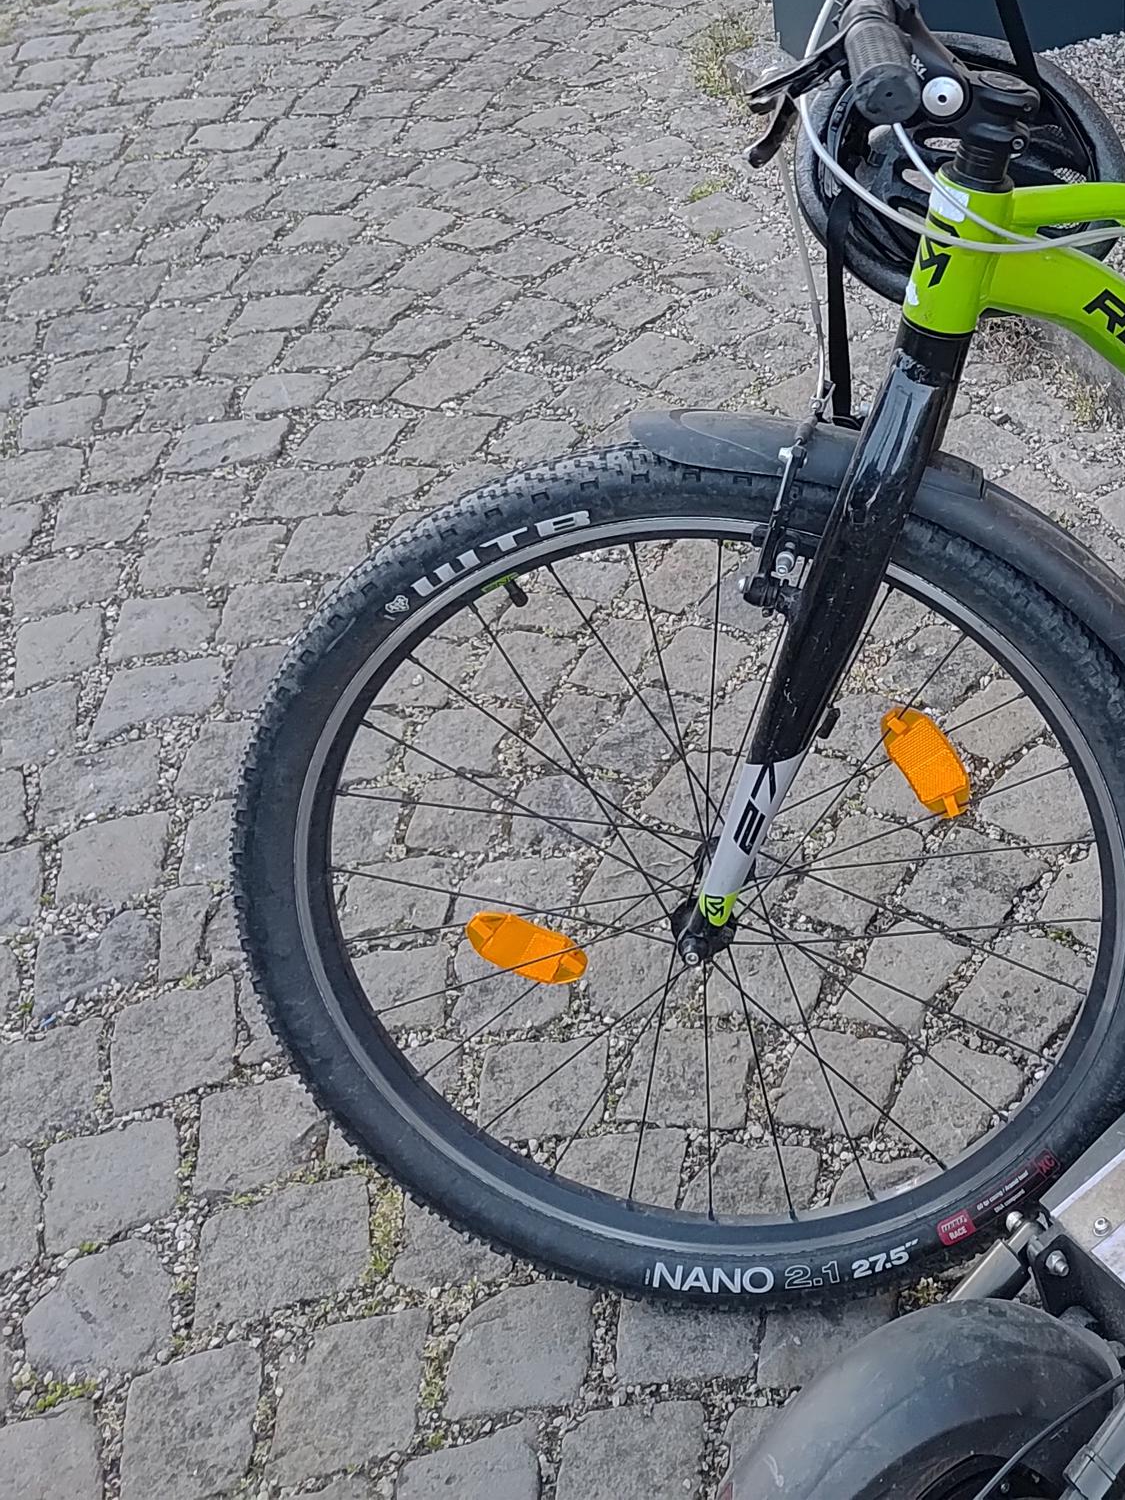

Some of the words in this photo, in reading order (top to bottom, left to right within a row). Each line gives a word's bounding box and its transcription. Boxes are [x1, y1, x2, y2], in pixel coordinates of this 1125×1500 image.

[948, 1225, 967, 1240] RACE
[652, 1262, 774, 1294] NANO
[784, 1260, 841, 1289] 2.1
